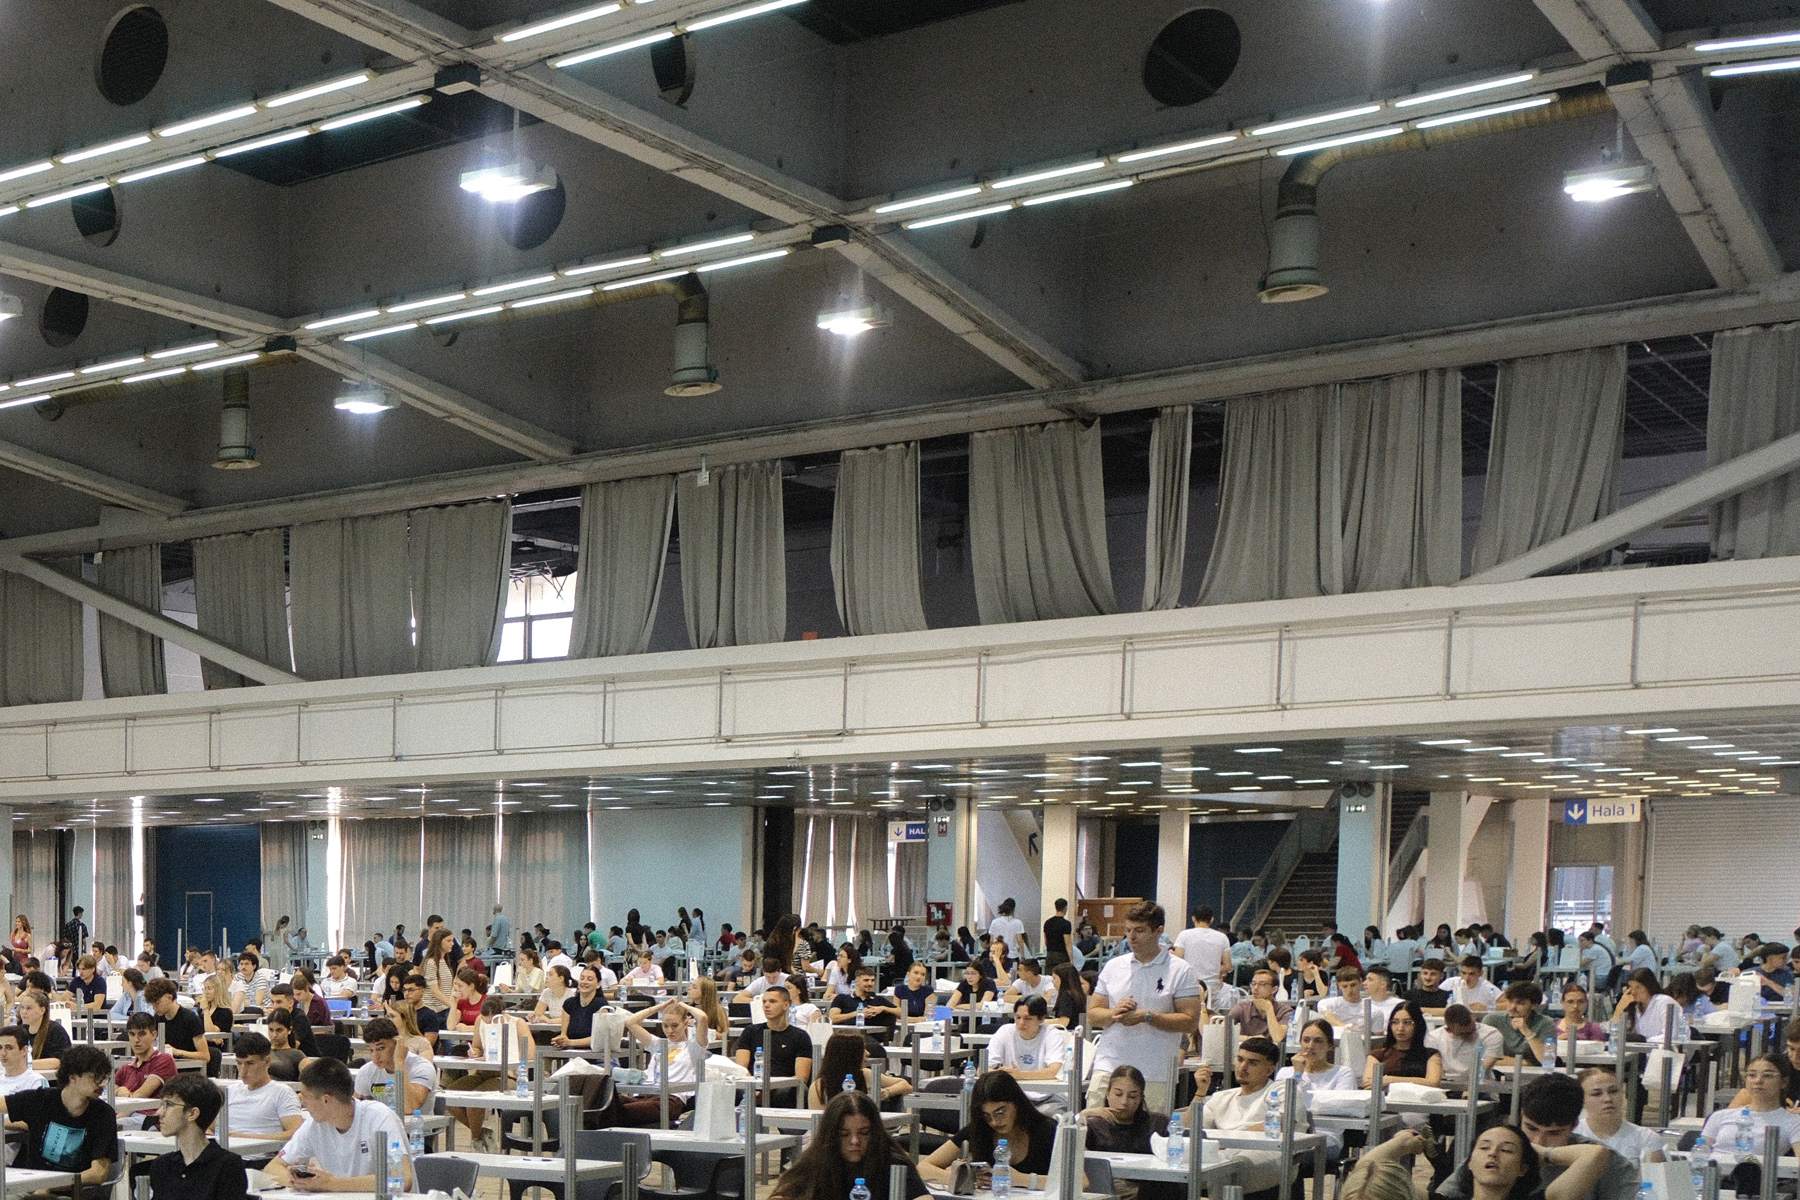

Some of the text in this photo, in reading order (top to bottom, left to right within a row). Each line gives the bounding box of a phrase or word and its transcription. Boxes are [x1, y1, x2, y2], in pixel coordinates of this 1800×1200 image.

[1592, 803, 1635, 817] Hala 1
[909, 827, 930, 835] HAL
